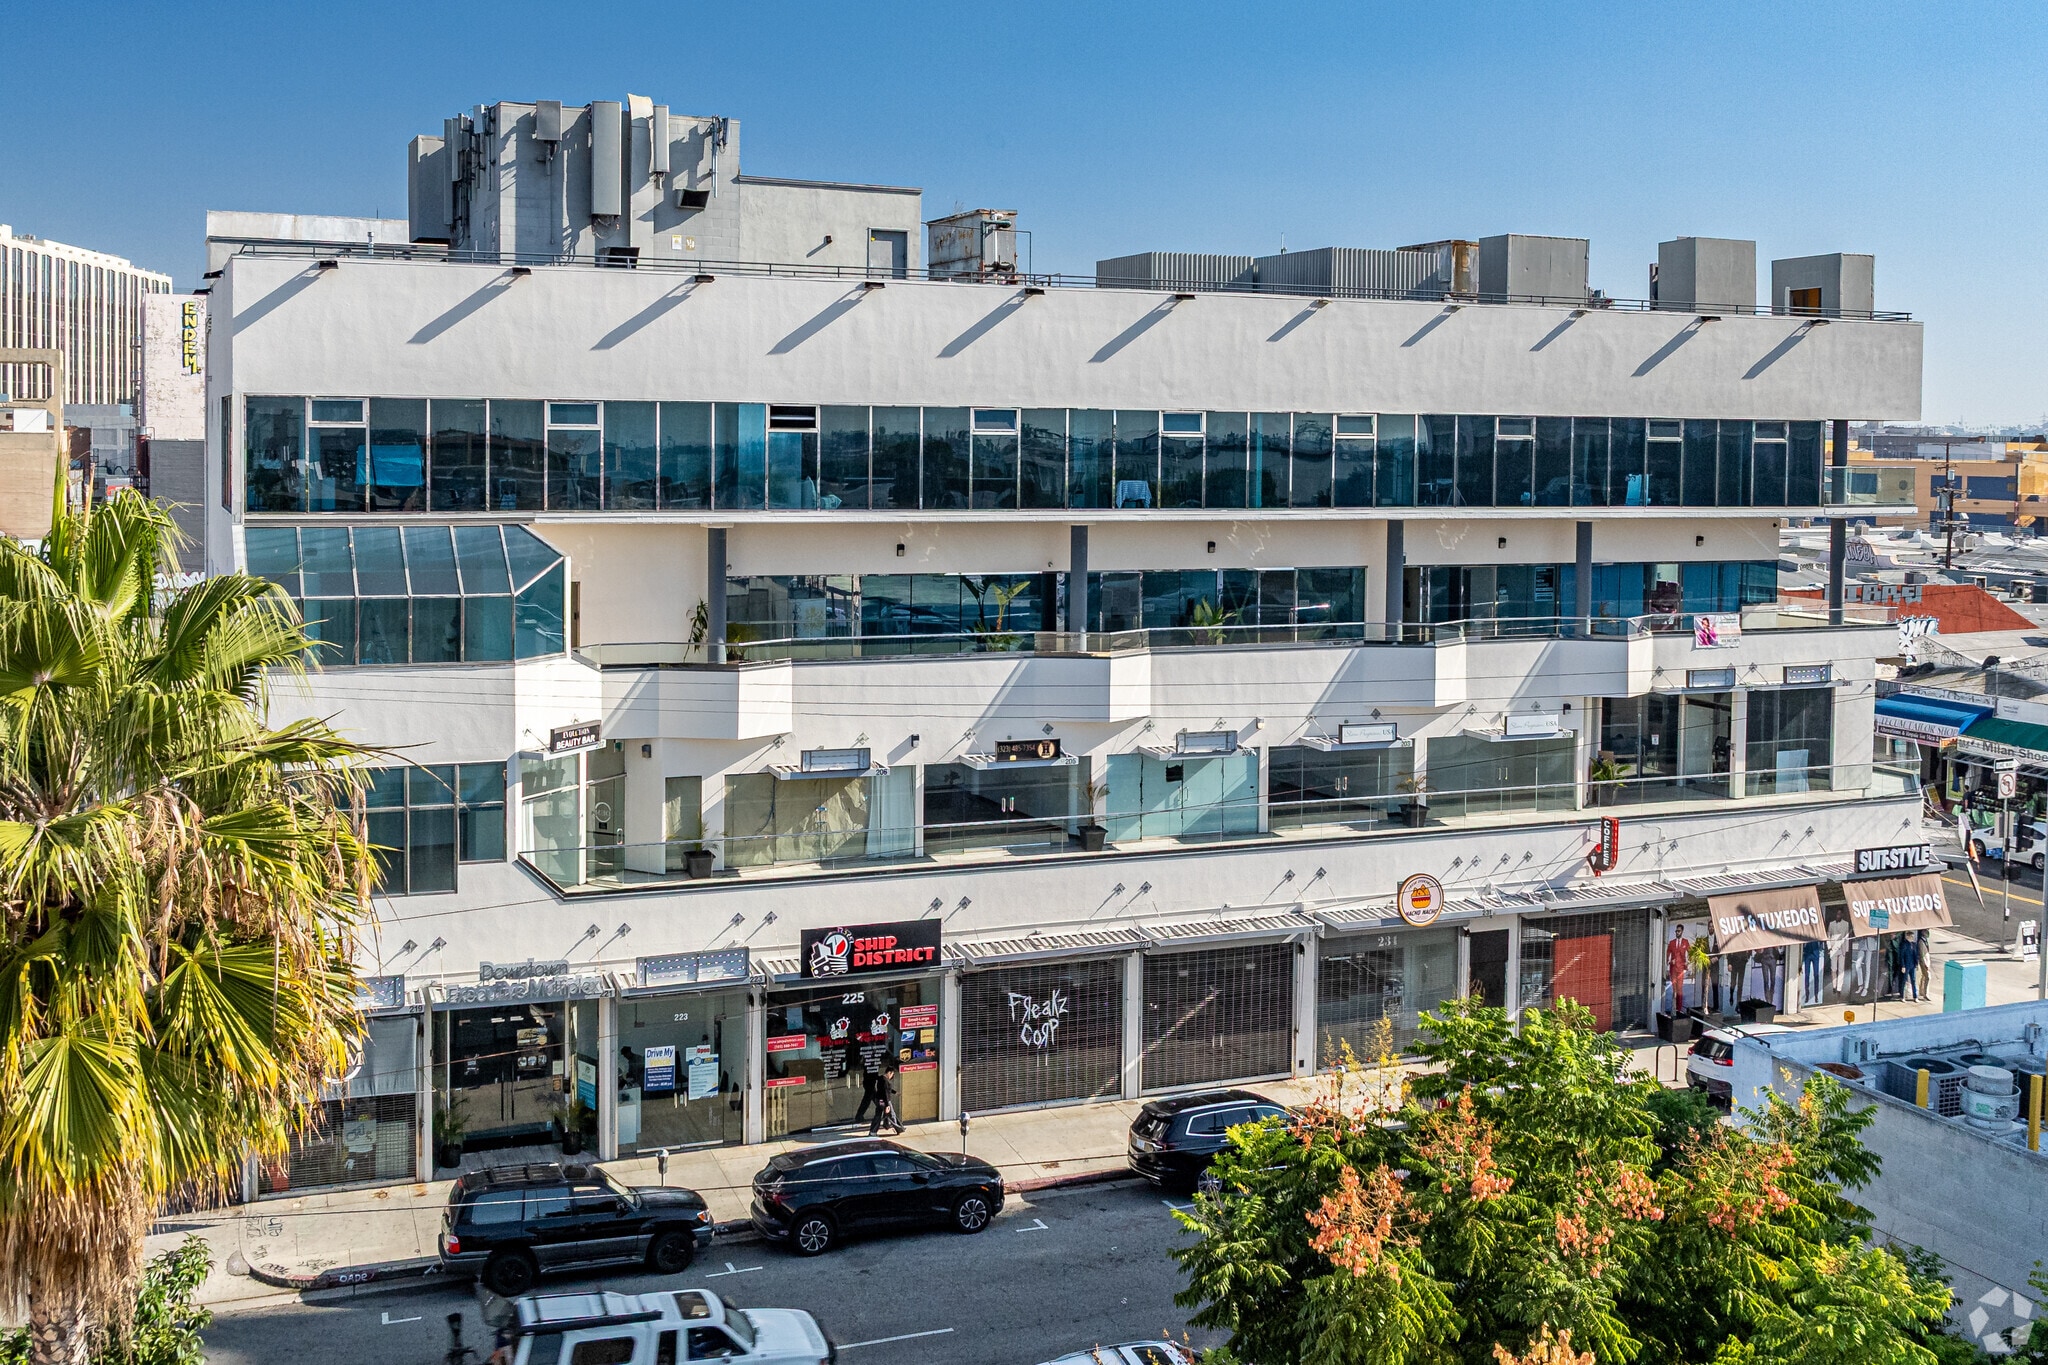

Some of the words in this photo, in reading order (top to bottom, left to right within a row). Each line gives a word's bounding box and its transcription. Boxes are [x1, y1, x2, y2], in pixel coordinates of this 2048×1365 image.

[1938, 726, 1959, 737] SHOP
[556, 737, 581, 750] BEAUTY
[581, 734, 596, 745] BAR
[1982, 740, 2015, 757] Milan
[1065, 757, 1077, 765] 205
[875, 768, 888, 776] 206
[1603, 820, 1611, 866] COFFEE
[1884, 893, 1942, 915] TUXEDOS
[1719, 915, 1746, 936] SUIT
[1747, 914, 1757, 932] &
[1757, 906, 1819, 931] TUXEDOS
[854, 935, 898, 952] SHIP
[1378, 935, 1398, 947] 231
[853, 947, 936, 967] DISTRICT
[951, 958, 964, 967] 225
[480, 959, 569, 981] Downtown
[842, 992, 865, 1005] 225
[409, 1005, 423, 1013] 219
[674, 1013, 689, 1022] 223
[647, 1049, 663, 1058] Drive
[664, 1047, 674, 1058] My
[913, 1048, 936, 1058] FedEx
